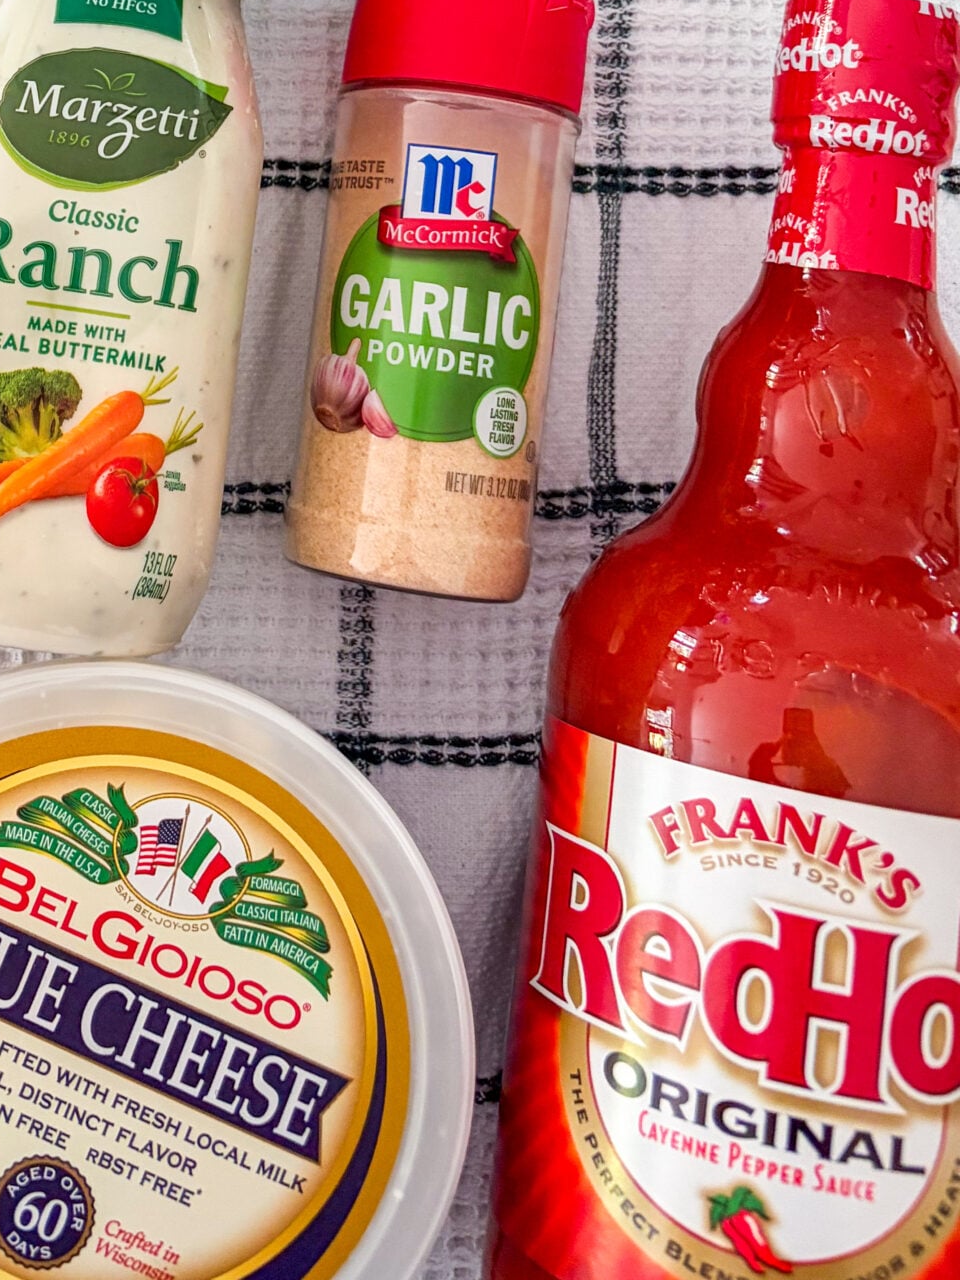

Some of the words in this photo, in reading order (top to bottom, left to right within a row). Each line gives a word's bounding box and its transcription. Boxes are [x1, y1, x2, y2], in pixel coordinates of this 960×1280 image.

[15, 79, 201, 160] Marzetti
[47, 129, 91, 148] 1896
[346, 160, 386, 174] TASTE
[48, 199, 140, 234] Classic
[384, 220, 504, 249] McCormick
[26, 316, 78, 337] MADE
[84, 322, 127, 344] WITH
[340, 273, 532, 351] GARLIC
[38, 337, 167, 373] BUTTERMILK
[366, 338, 495, 380] POWDER
[489, 408, 519, 422] LASTING
[496, 397, 516, 410] LONG
[489, 432, 515, 446] FLAVOR
[492, 420, 515, 433] FRESH
[38, 797, 74, 827] ITALIAN
[72, 820, 110, 855] CHEESES
[80, 792, 118, 825] CLASSIC
[5, 825, 39, 845] MADE
[40, 834, 53, 850] IN
[54, 841, 76, 862] THE
[648, 796, 922, 910] FRANK'S
[115, 884, 134, 904] SAY
[250, 876, 300, 896] FORMAGGI
[699, 852, 778, 872] SINCE
[792, 861, 857, 905] 1920
[235, 903, 278, 921] CLASSICI
[280, 911, 320, 933] ITALIANI
[223, 925, 253, 944] FATTI
[255, 932, 269, 949] IN
[269, 939, 320, 974] AMERICA
[531, 823, 960, 1112] RedHo
[80, 982, 329, 1147] CHEESE
[15, 1112, 71, 1151] FREE
[18, 1082, 115, 1136] DISTINCT
[115, 1127, 198, 1176] FLAVOR
[56, 1066, 110, 1104] WITH
[111, 1093, 182, 1138] FRESH
[183, 1126, 253, 1170] LOCAL
[255, 1158, 308, 1195] MILK
[602, 1050, 926, 1176] ORIGINAL
[7, 1166, 57, 1198] AGED
[60, 1176, 85, 1232] OVER
[14, 1191, 69, 1242] 60
[6, 1231, 52, 1259] DAYS
